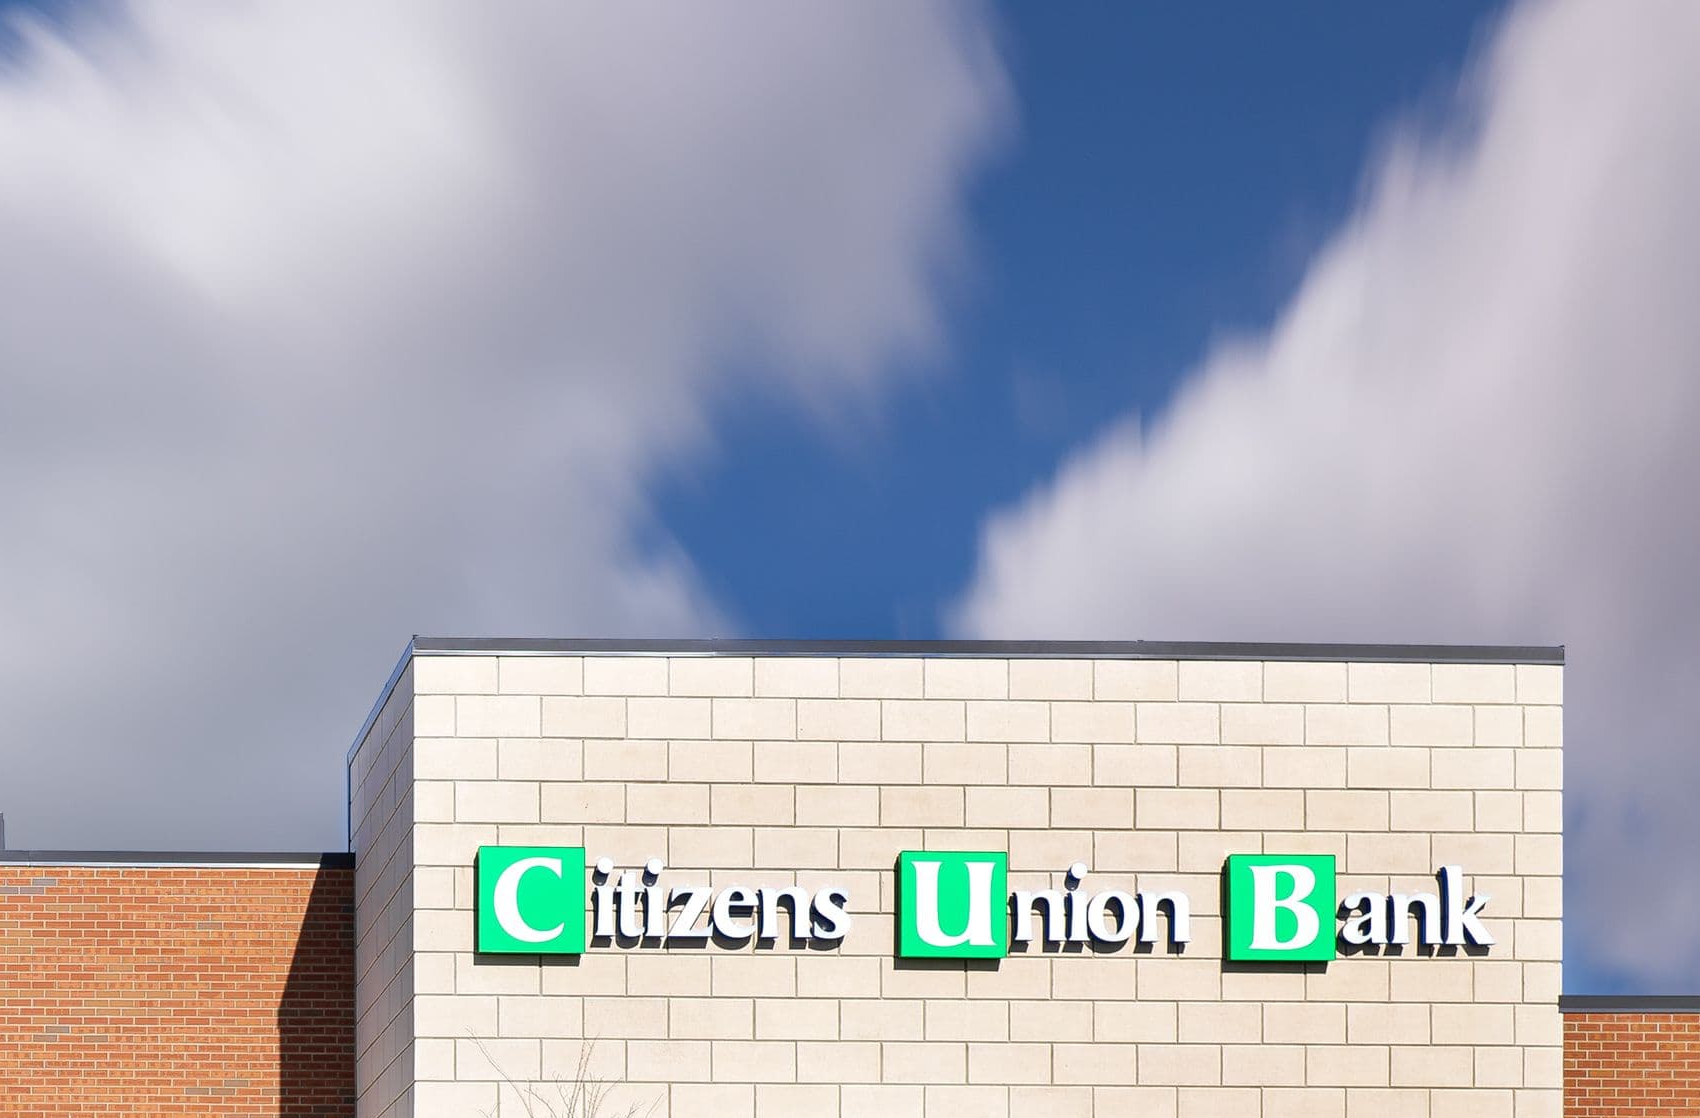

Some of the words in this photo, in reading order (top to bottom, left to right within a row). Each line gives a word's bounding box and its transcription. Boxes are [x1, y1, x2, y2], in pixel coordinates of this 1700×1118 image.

[492, 856, 852, 943] Citizens
[910, 860, 1192, 948] Union
[1246, 863, 1497, 951] Bank
